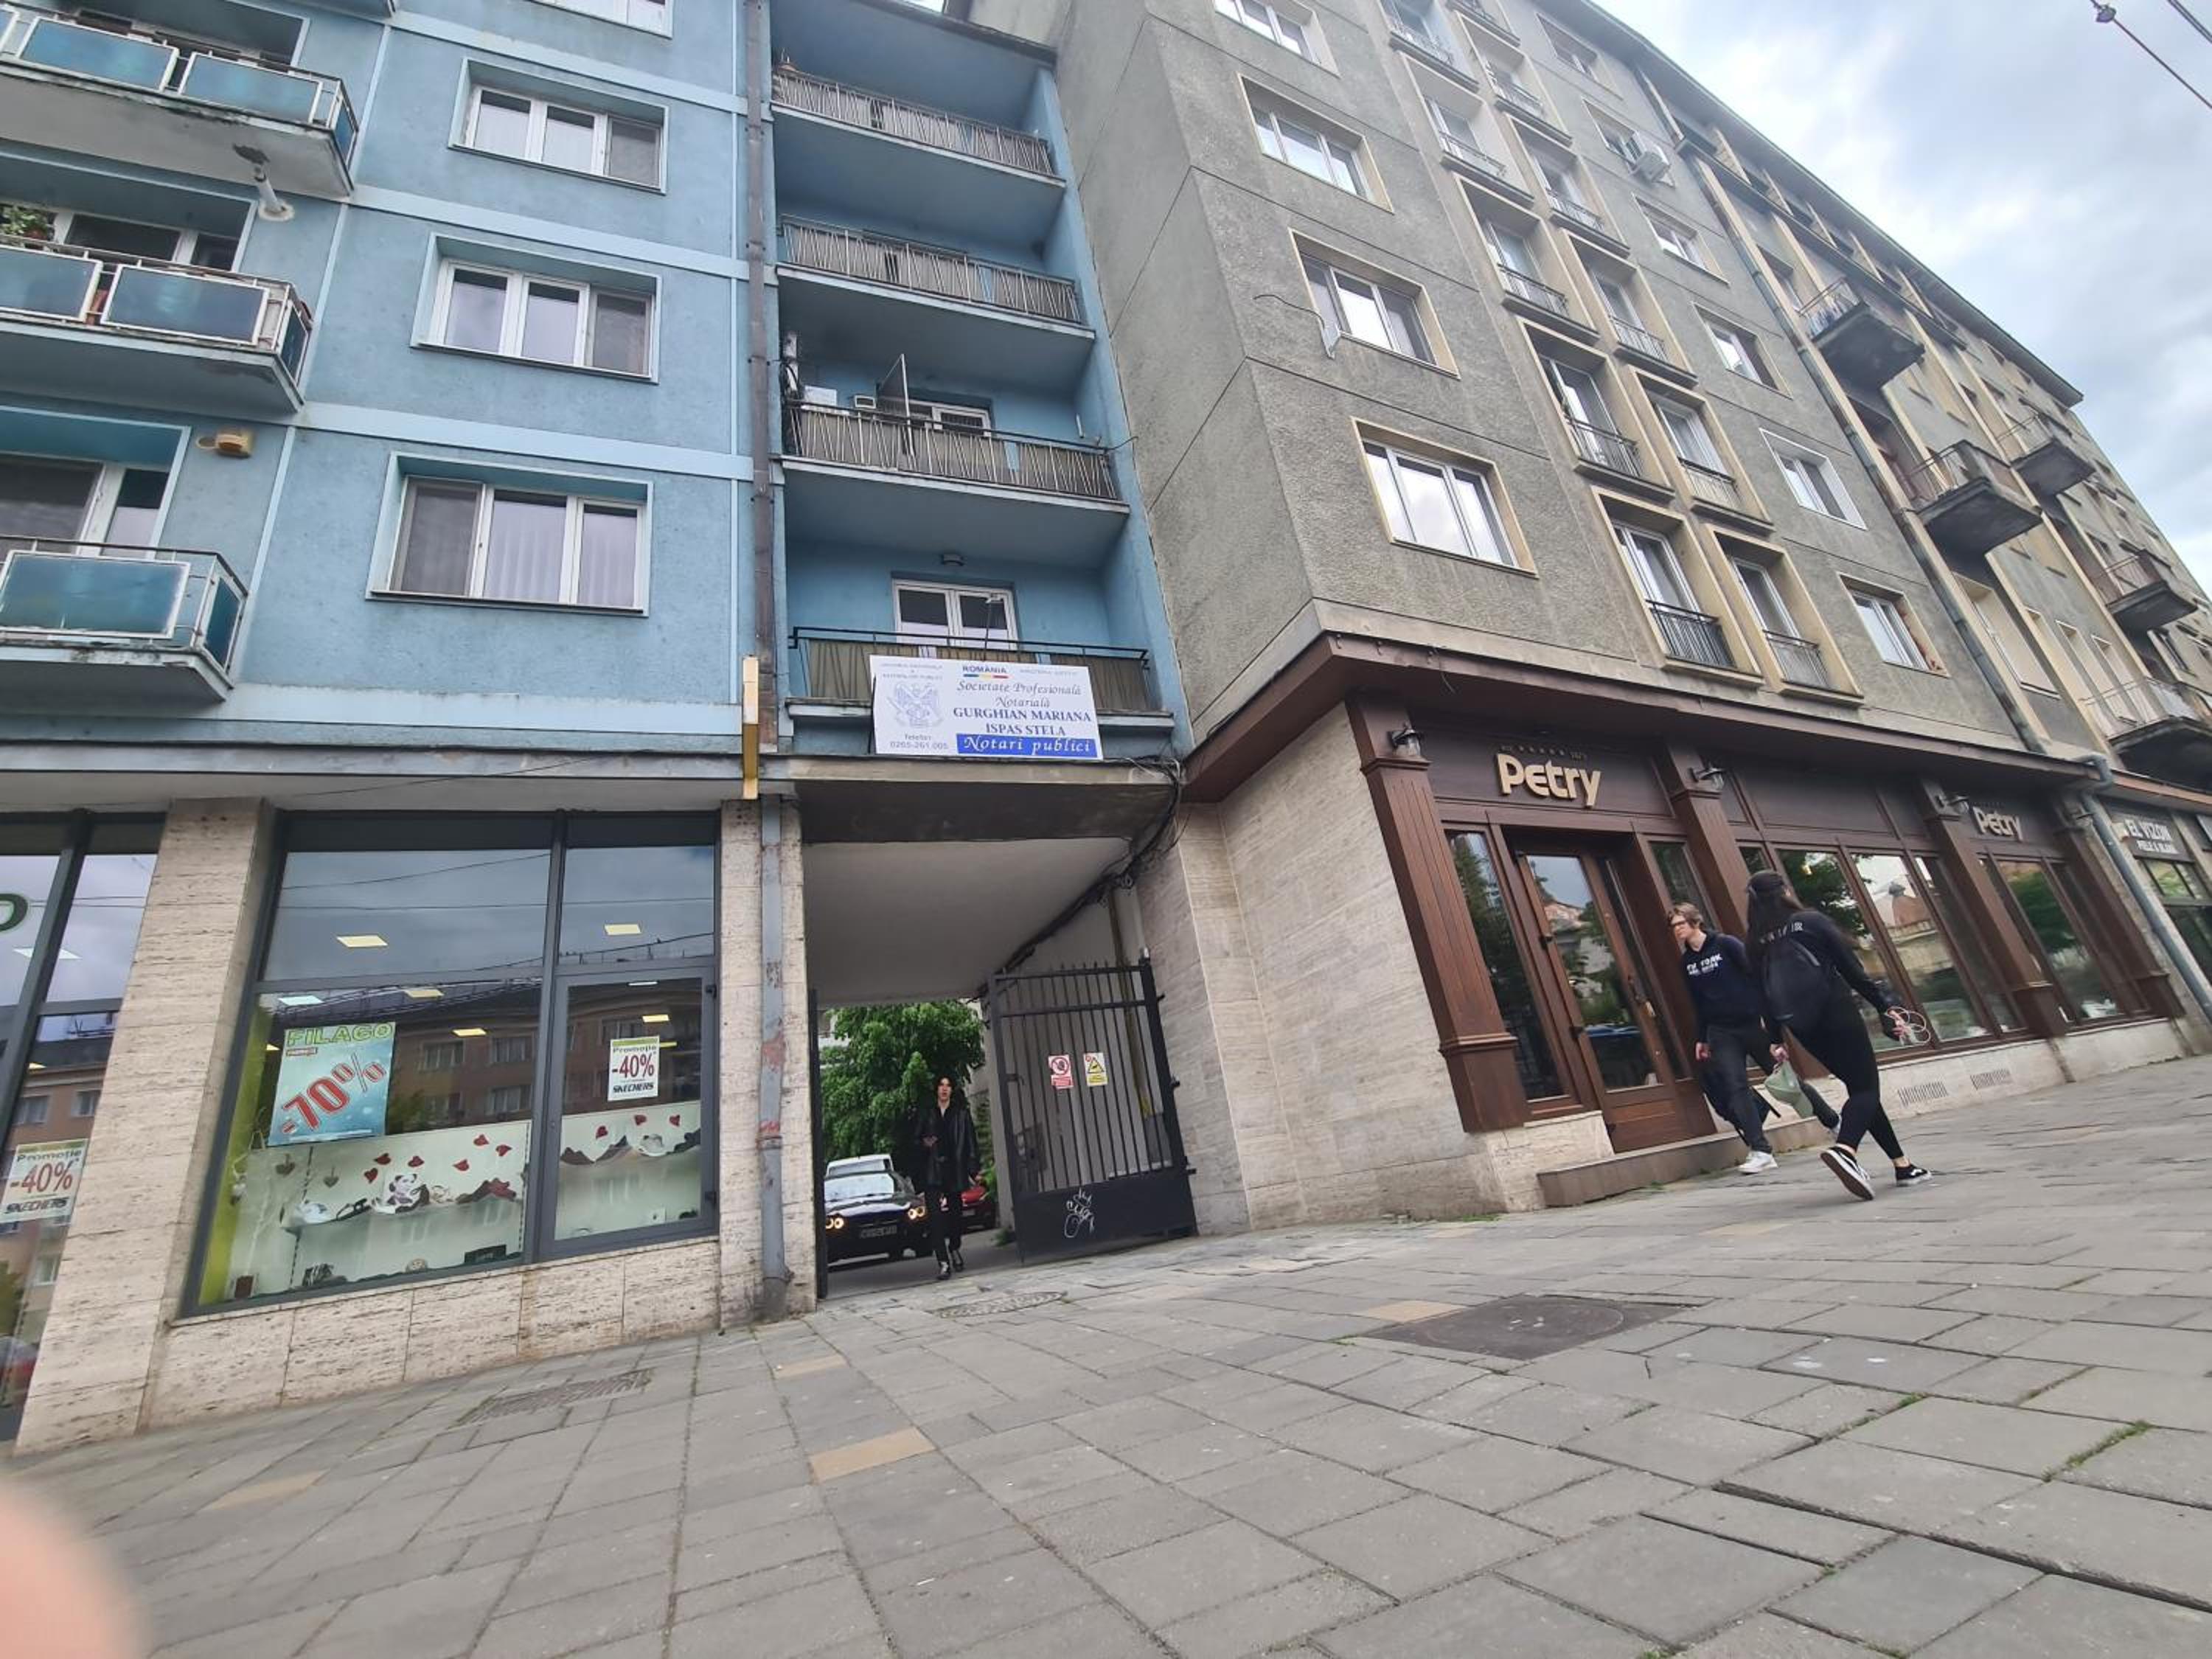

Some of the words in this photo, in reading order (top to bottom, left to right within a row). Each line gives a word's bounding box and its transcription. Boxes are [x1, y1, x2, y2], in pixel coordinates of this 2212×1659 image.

[956, 680, 1010, 692] Societate
[953, 707, 1027, 720] GURGHIAN
[1032, 710, 1091, 722] MARIANA
[986, 723, 1023, 734] ISPAS
[1026, 726, 1066, 737] STELA
[964, 735, 1023, 752] Notari
[1032, 737, 1090, 756] publici
[1498, 753, 1601, 807] Petry
[1973, 806, 2023, 841] Petry
[288, 1023, 393, 1046] FILAGO
[282, 1050, 386, 1133] -70%
